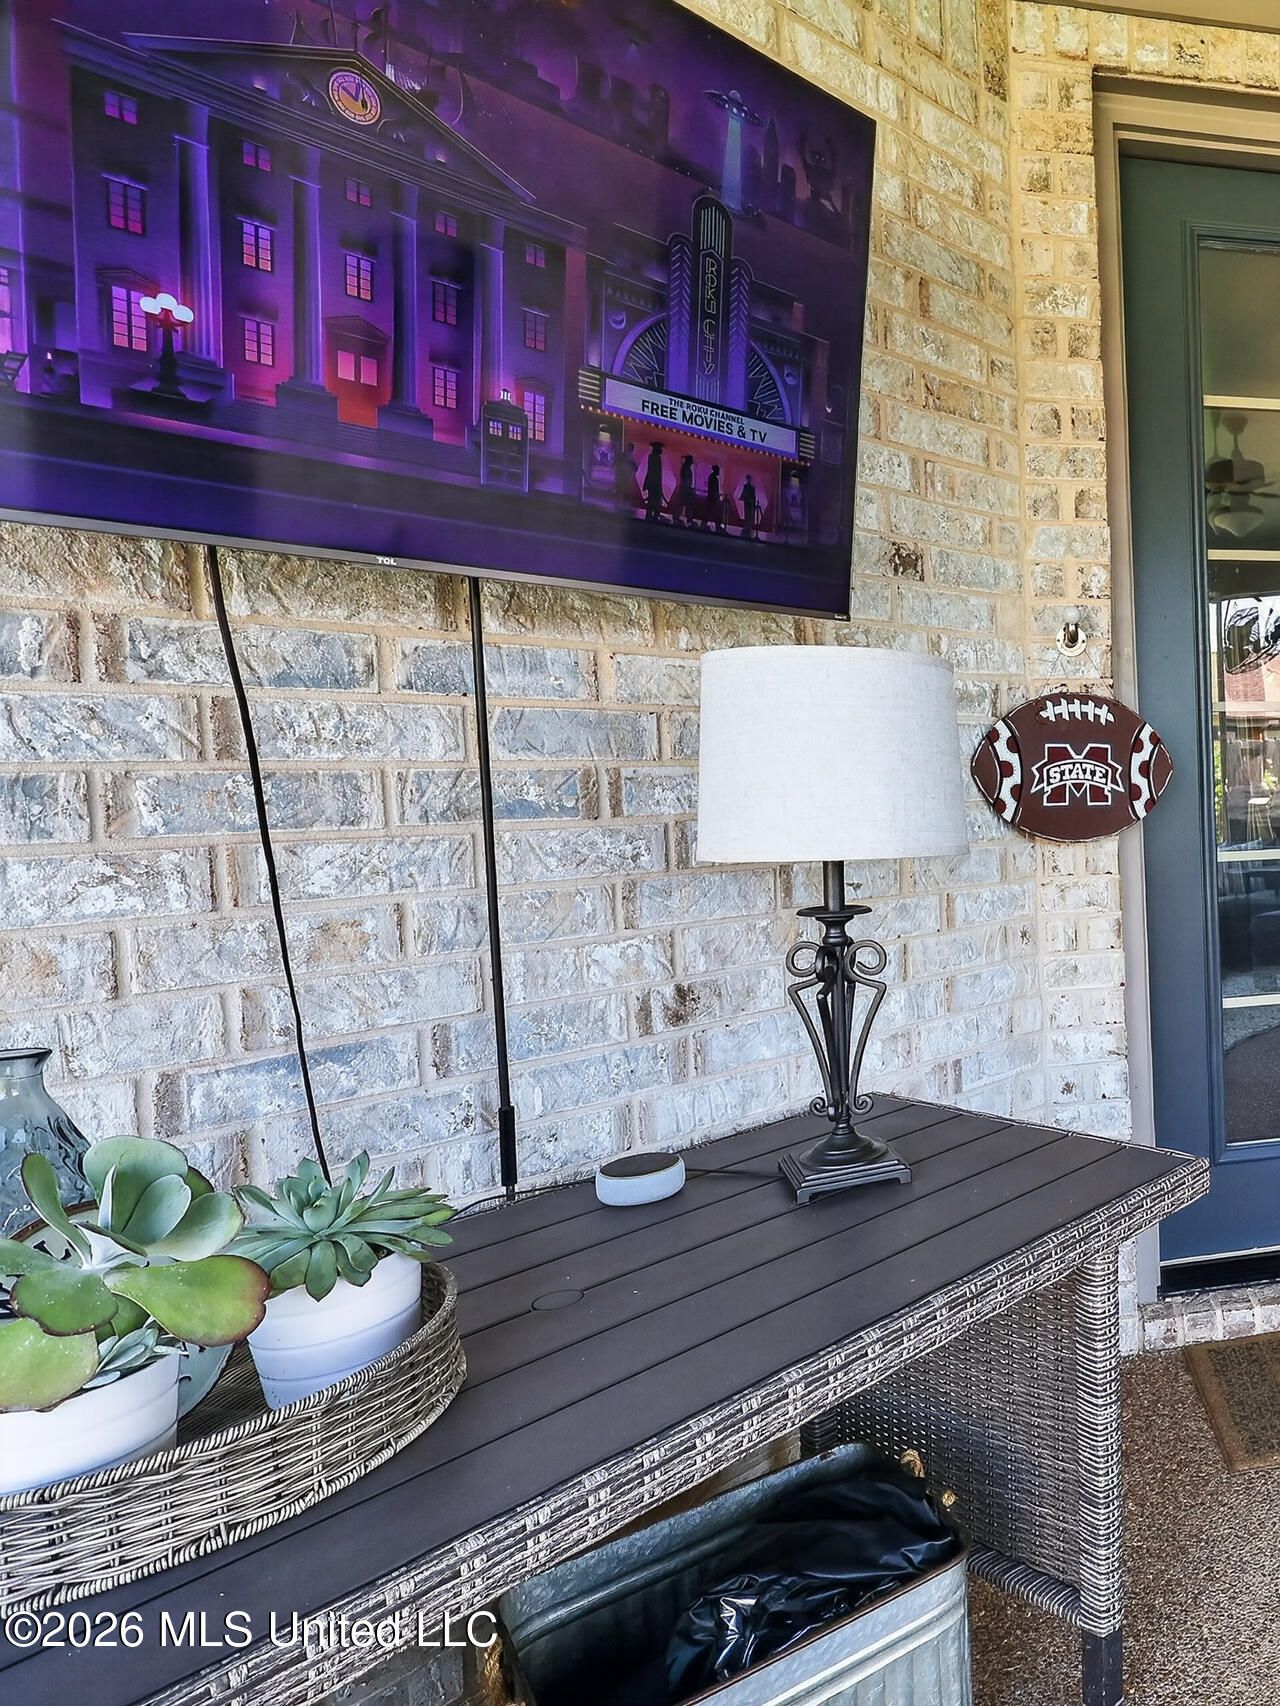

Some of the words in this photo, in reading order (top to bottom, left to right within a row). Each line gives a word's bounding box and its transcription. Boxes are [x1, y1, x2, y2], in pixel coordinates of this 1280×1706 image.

[705, 257, 718, 315] ROKU
[703, 319, 716, 375] CITY
[641, 399, 678, 421] FREE
[681, 410, 734, 436] MOVIES
[737, 424, 747, 440] &
[749, 428, 768, 444] TV
[669, 398, 685, 409] THE
[685, 401, 709, 415] ROKU
[709, 409, 745, 425] CHANNEL
[376, 555, 397, 566] TCL
[1049, 762, 1108, 784] STATE
